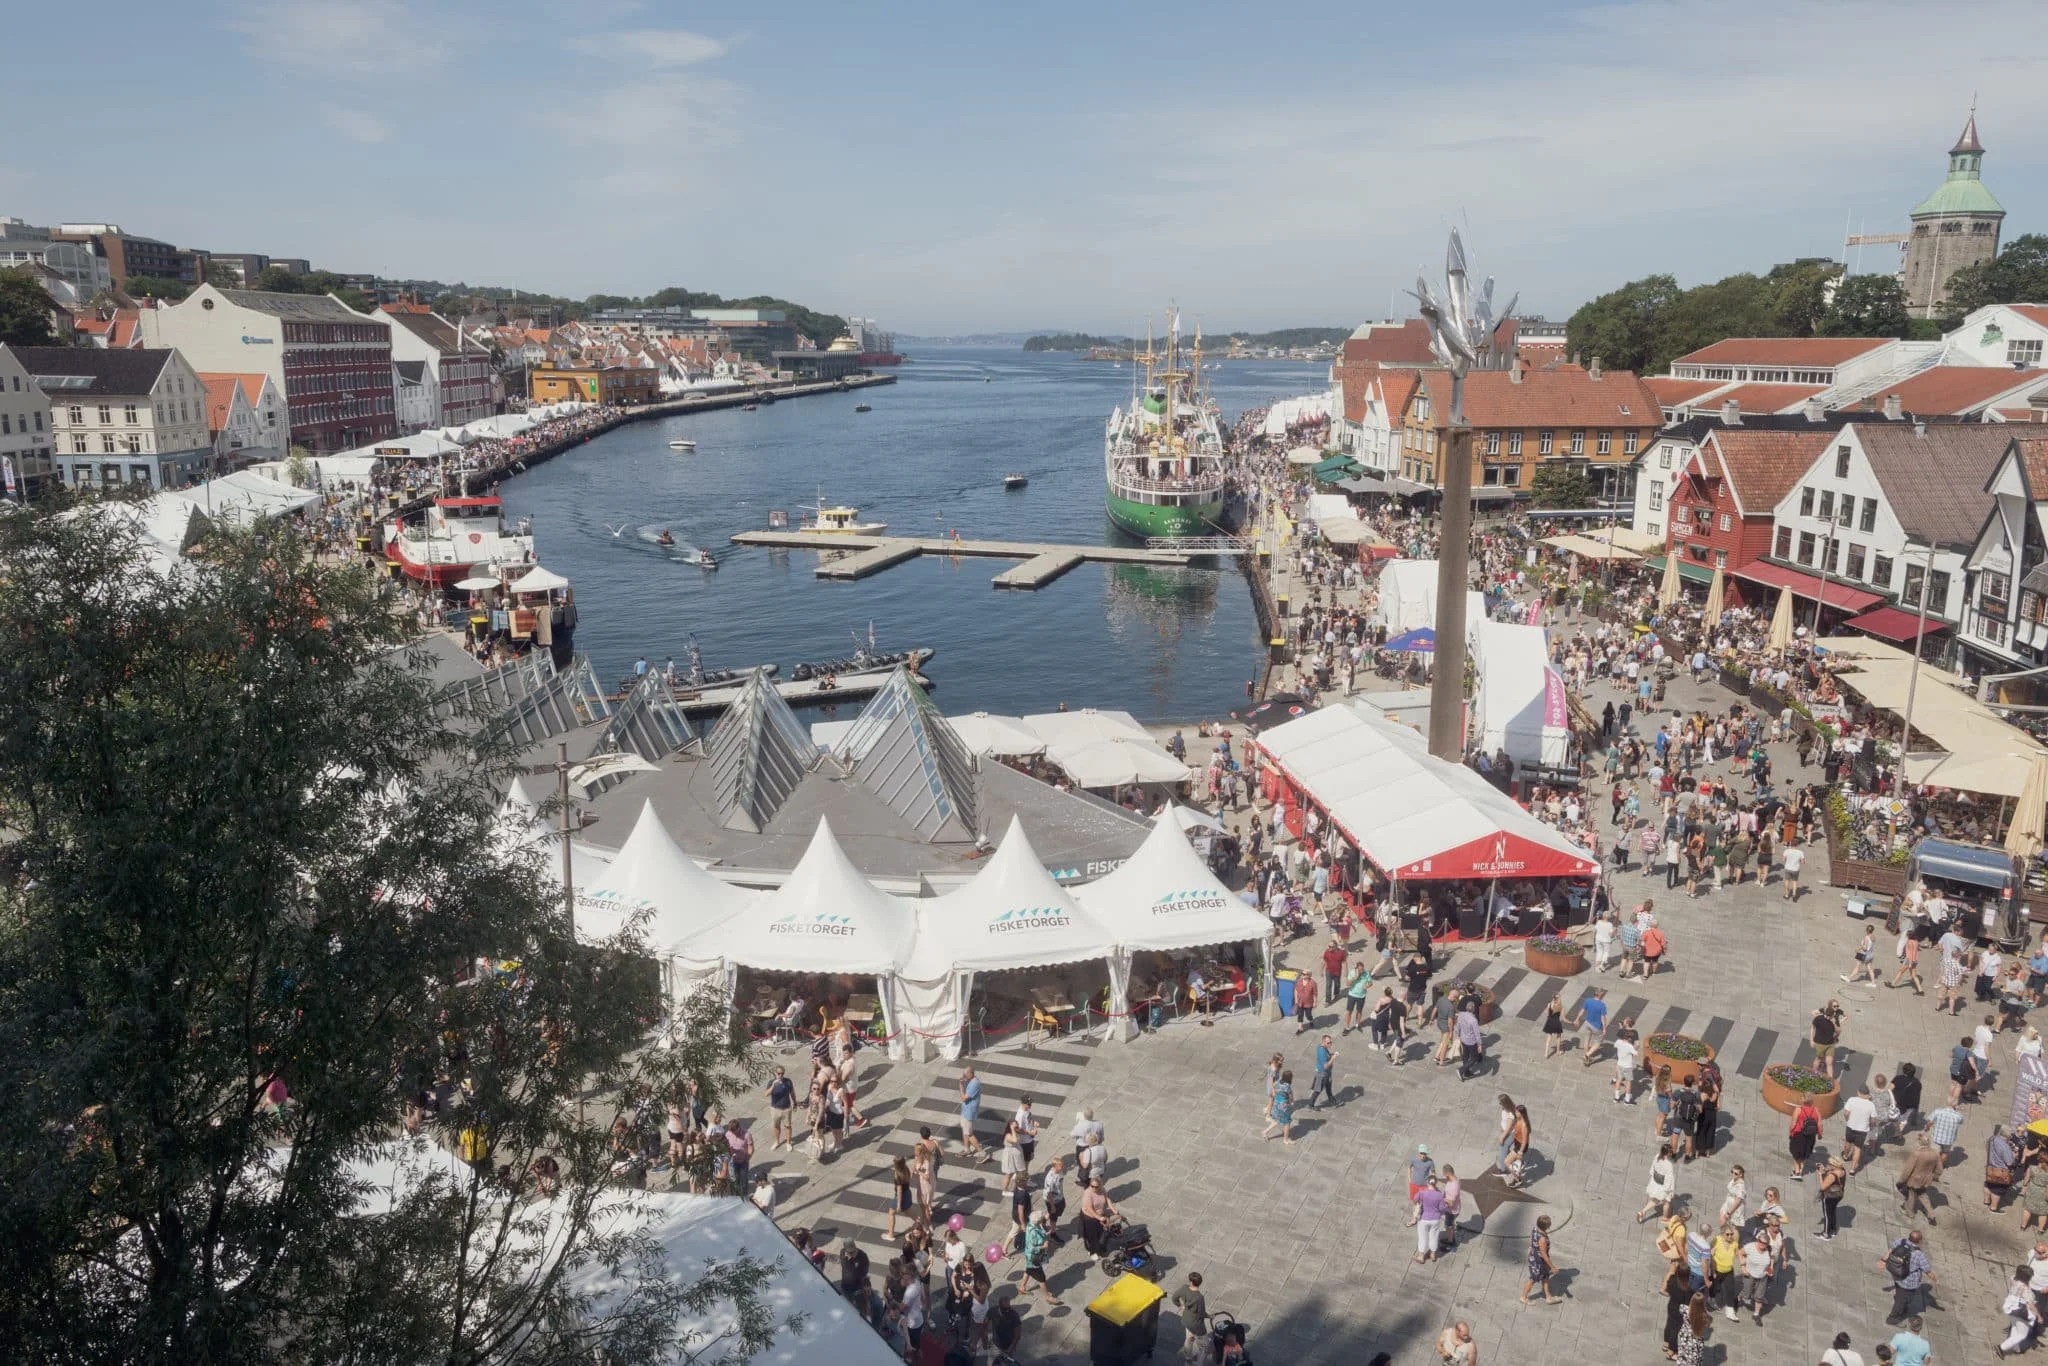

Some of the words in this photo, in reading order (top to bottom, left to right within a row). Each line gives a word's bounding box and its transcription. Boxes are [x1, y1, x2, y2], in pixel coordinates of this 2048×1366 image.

[1472, 862, 1489, 871] NICK
[1497, 861, 1525, 870] JONNIES
[1151, 898, 1228, 916] FISKETORGET
[769, 923, 857, 936] FISKETORGET
[988, 917, 1072, 933] FISKETORGET
